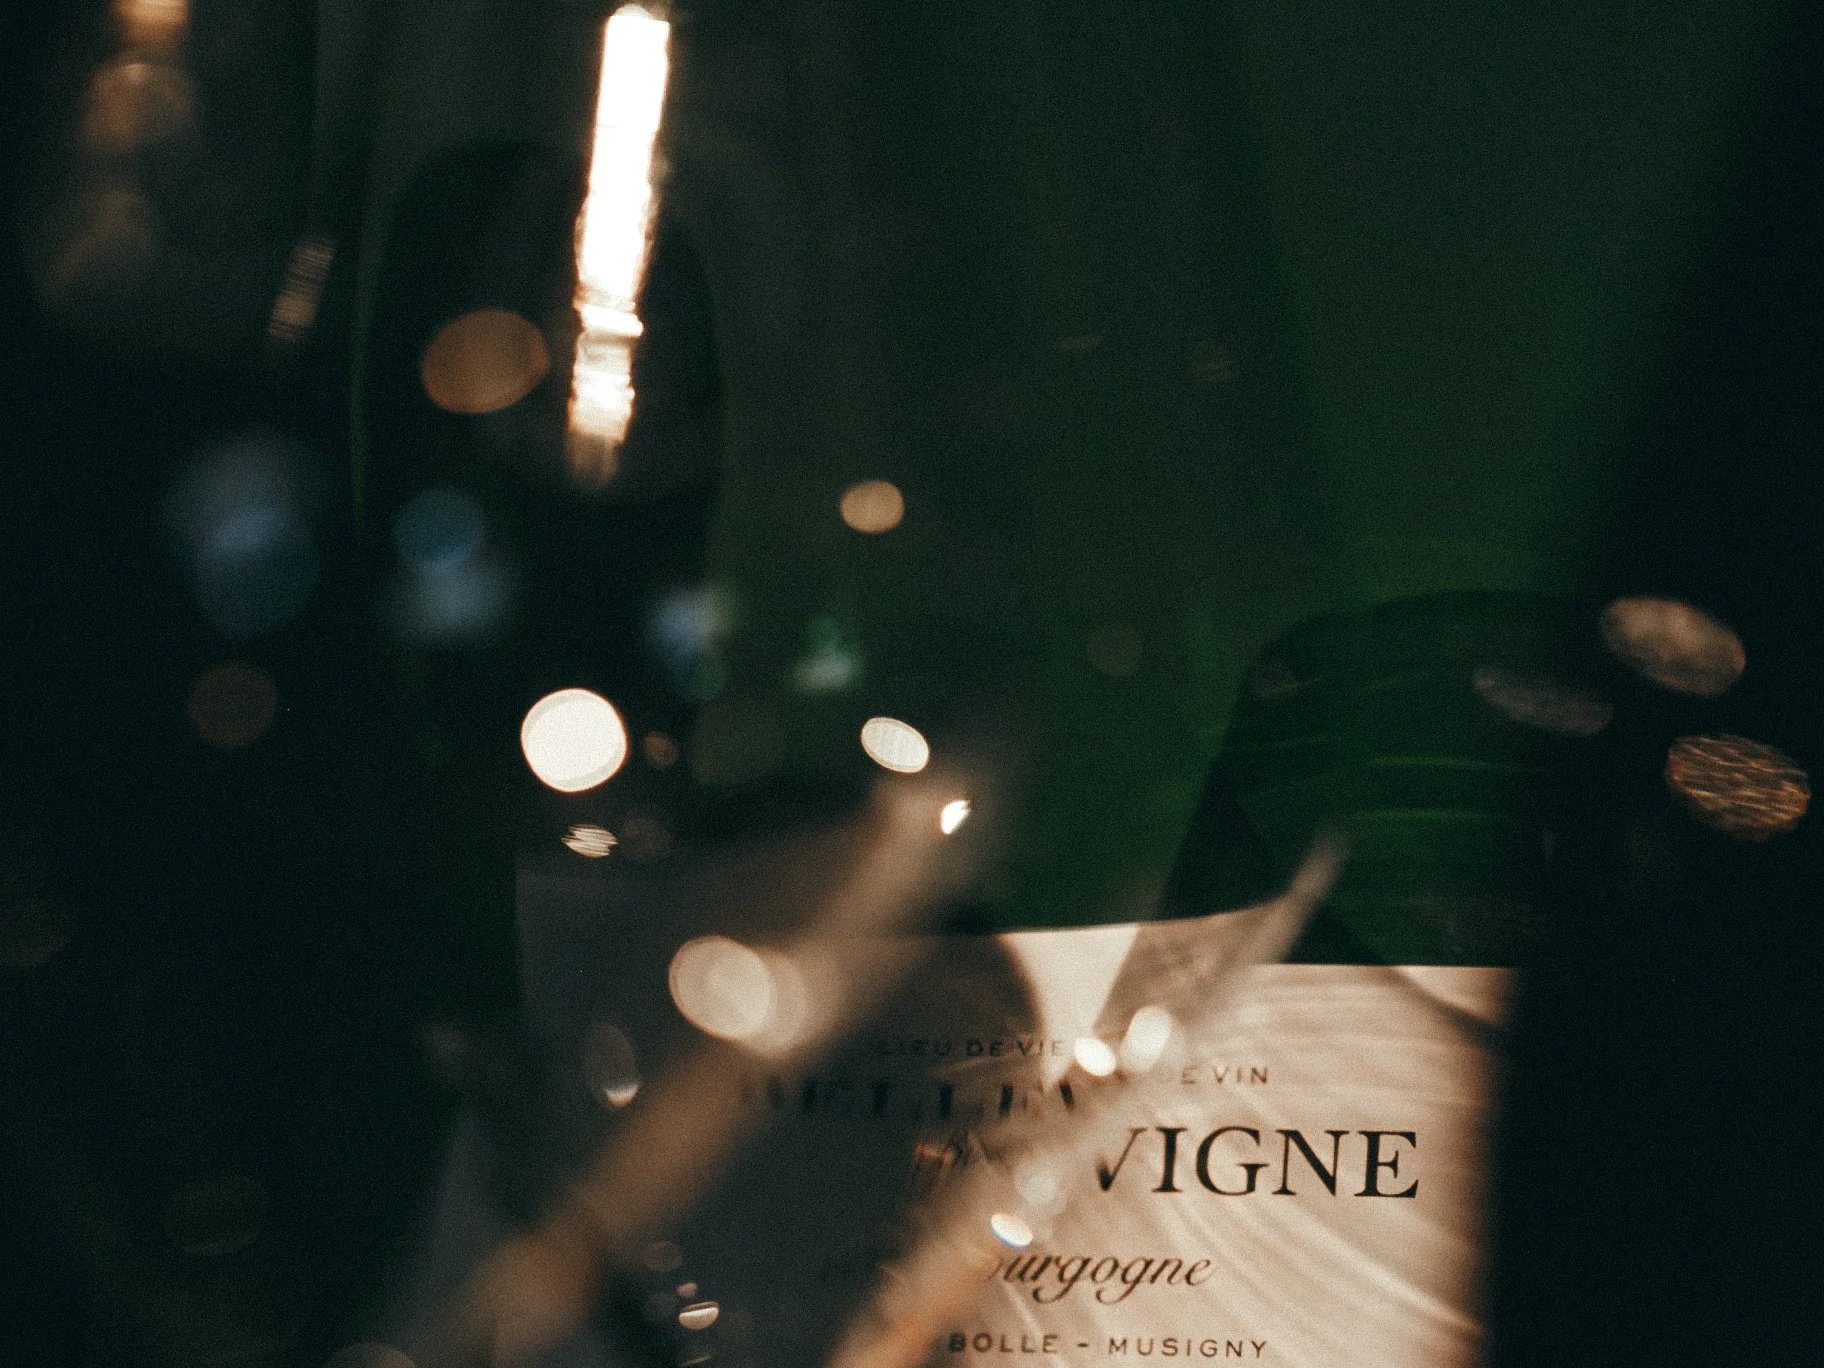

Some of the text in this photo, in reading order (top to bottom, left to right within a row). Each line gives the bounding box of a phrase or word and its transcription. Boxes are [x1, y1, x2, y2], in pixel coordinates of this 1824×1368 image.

[1213, 1066, 1270, 1086] VIN
[988, 1252, 1213, 1304] urgogne
[947, 1332, 1059, 1354] BOLLE
[1108, 1337, 1268, 1359] MUSIGNY
